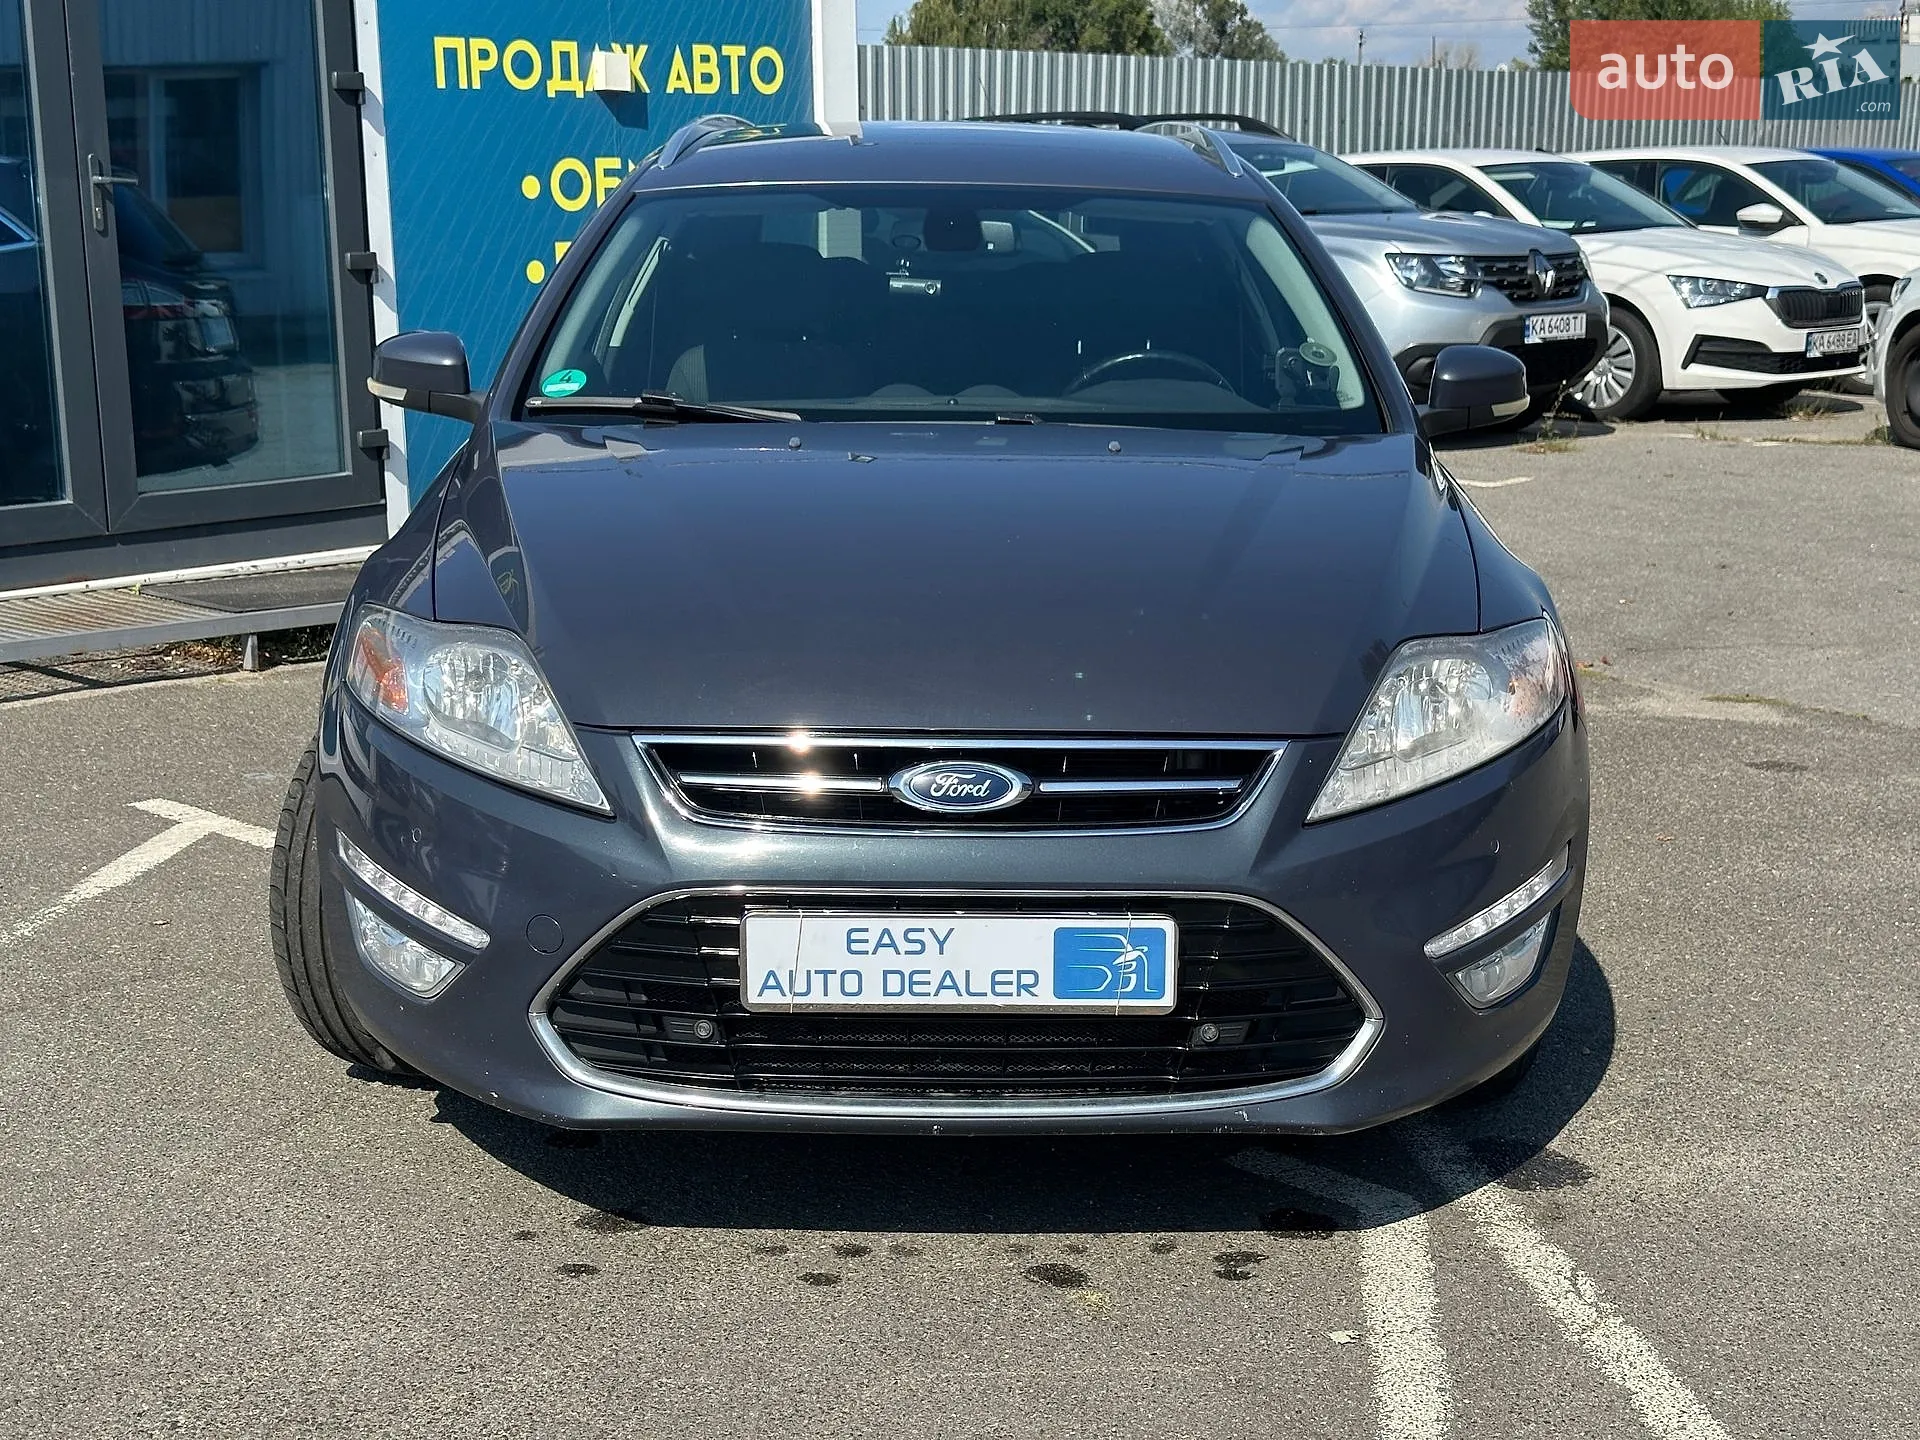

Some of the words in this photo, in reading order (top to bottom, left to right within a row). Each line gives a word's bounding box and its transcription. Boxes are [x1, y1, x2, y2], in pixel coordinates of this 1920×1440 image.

[666, 44, 785, 95] АВТО
[559, 371, 573, 383] 4
[930, 772, 992, 798] Ford
[846, 927, 955, 956] EASY
[757, 969, 863, 998] AUTO
[882, 969, 1040, 998] DEALER
